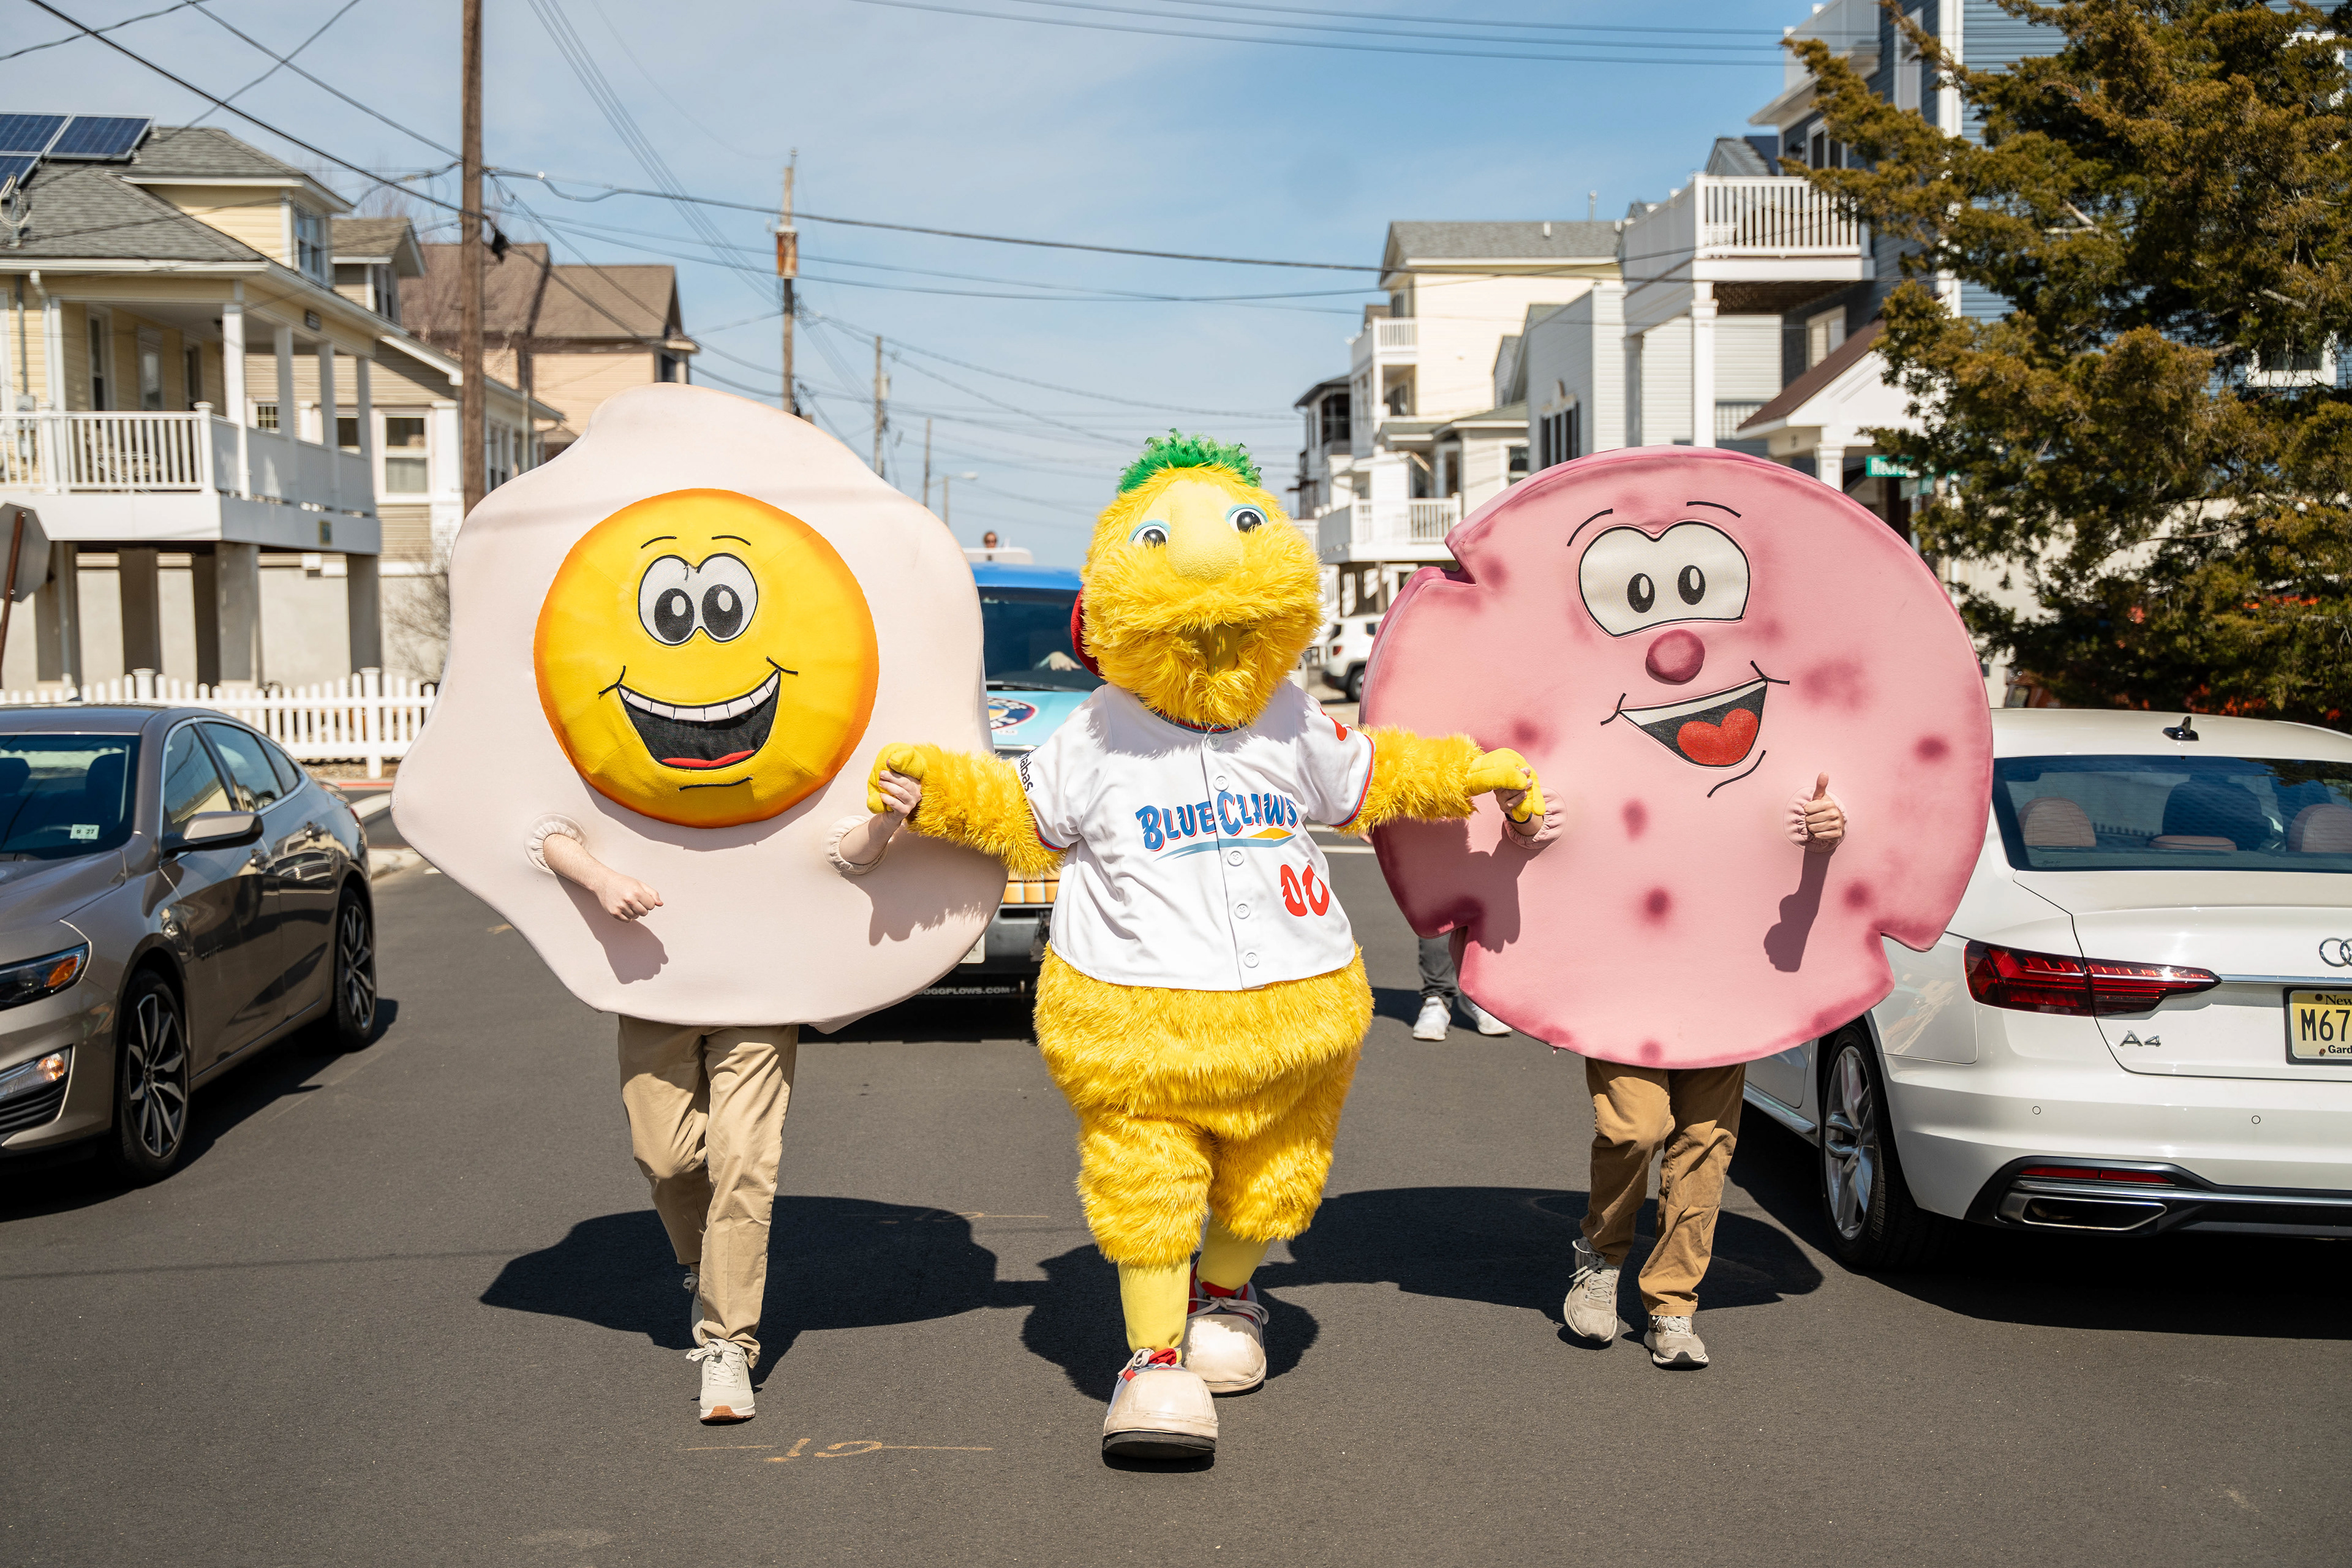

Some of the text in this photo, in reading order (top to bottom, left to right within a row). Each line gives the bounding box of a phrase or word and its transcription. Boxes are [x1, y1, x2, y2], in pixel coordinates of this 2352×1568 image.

[1280, 864, 1330, 916] 00
[2325, 995, 2352, 1005] New
[2301, 1009, 2350, 1042] M67
[2119, 1030, 2162, 1047] A4
